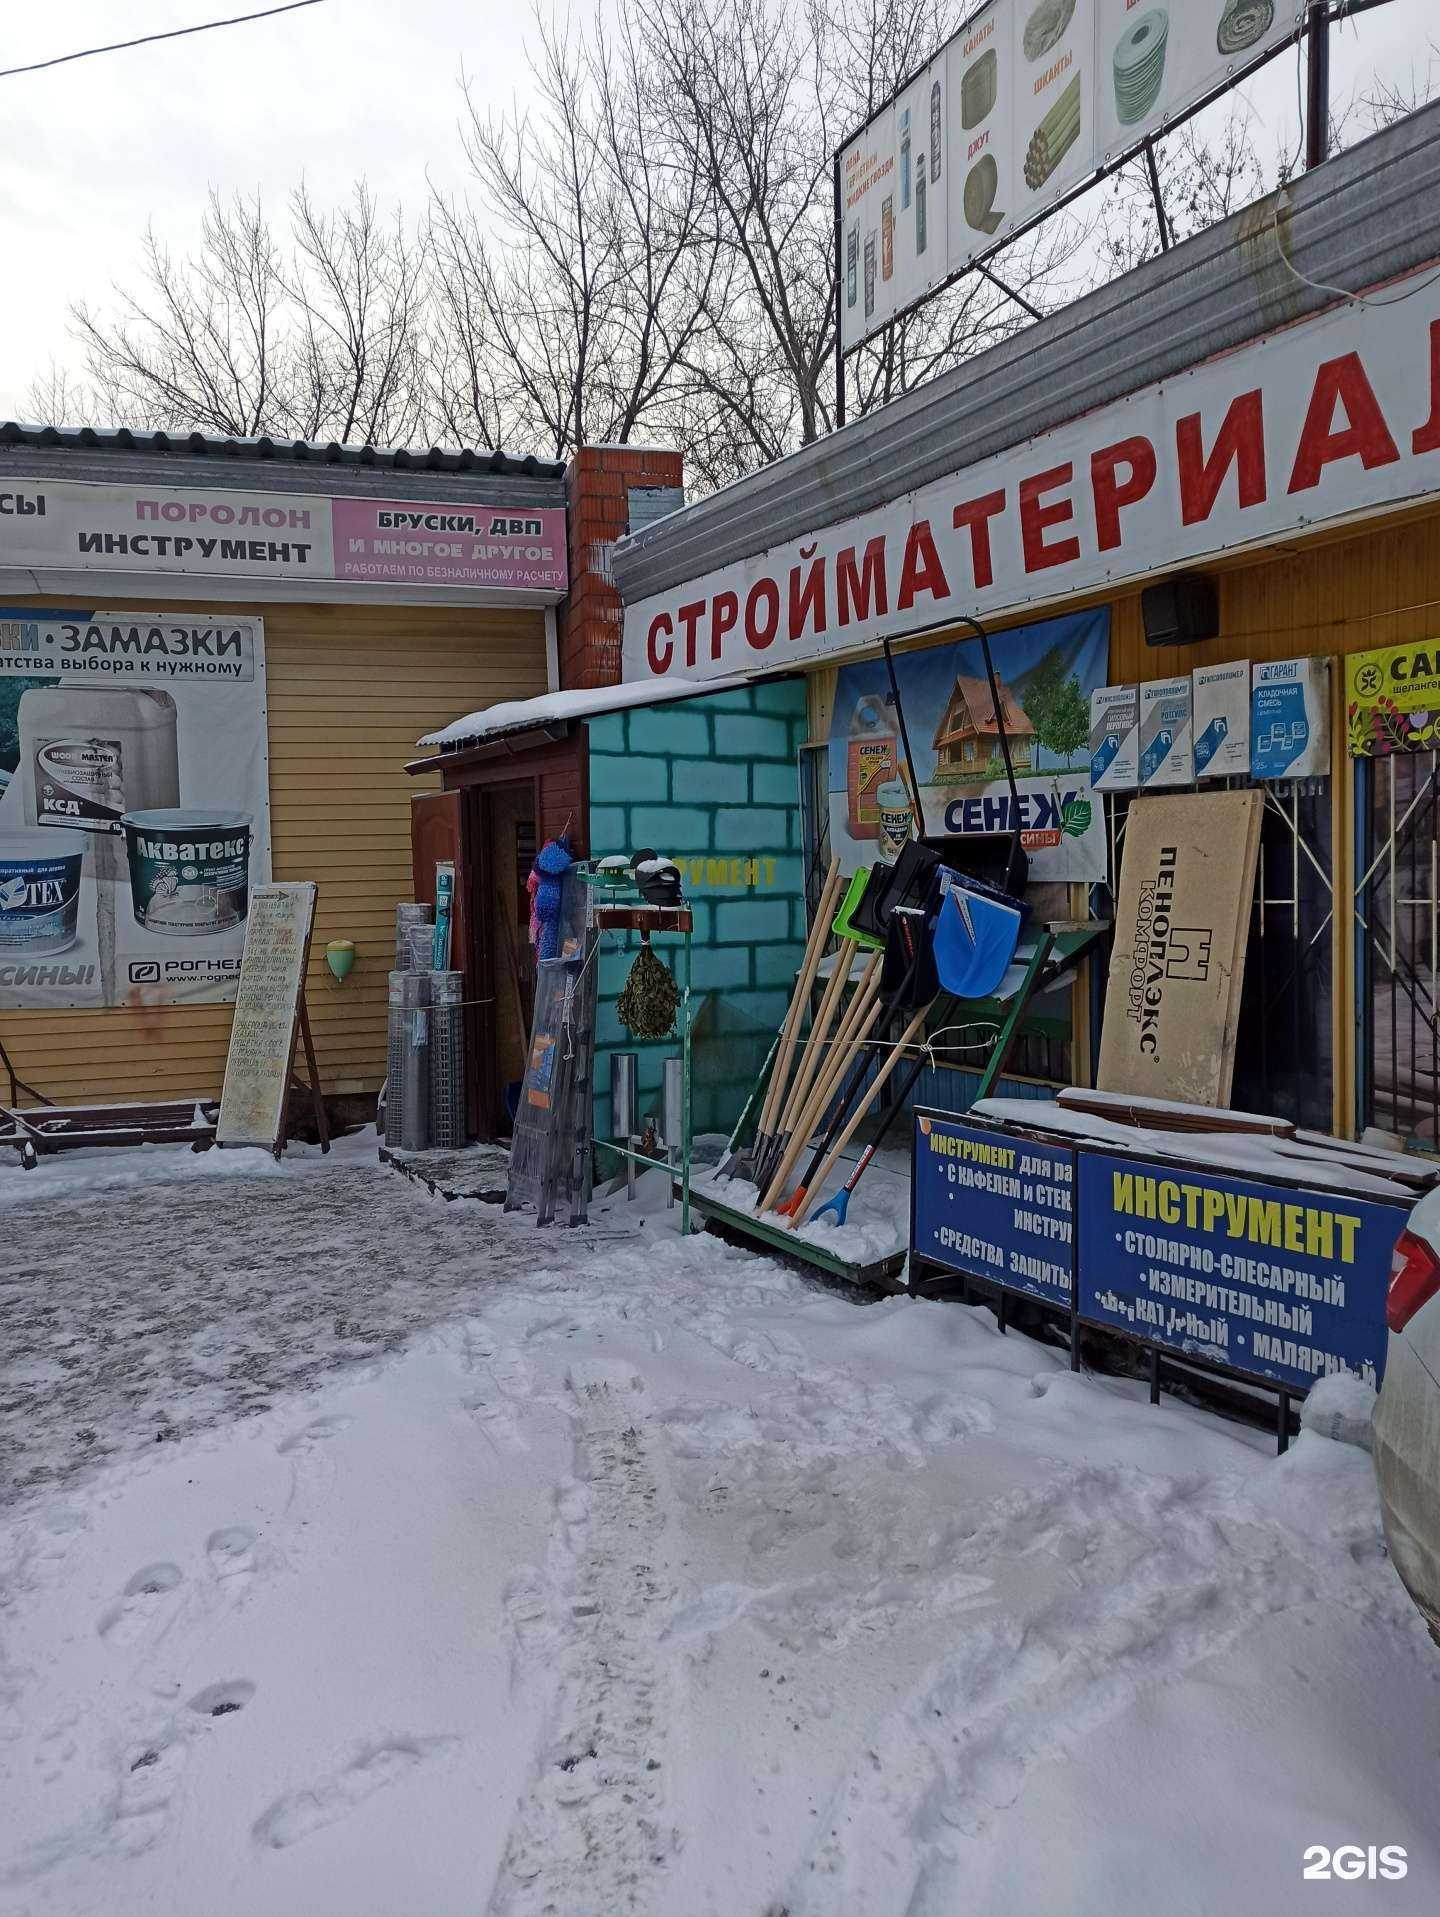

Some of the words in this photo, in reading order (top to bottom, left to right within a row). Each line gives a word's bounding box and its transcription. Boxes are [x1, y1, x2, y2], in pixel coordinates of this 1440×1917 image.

[963, 18, 995, 58] КАНАТЫ
[1033, 50, 1072, 95] ШКАНТЫ
[967, 130, 990, 161] ДЖУТ
[136, 500, 311, 529] ПОРОЛОН
[377, 511, 482, 536] БРУСКИ,
[489, 516, 543, 537] ДВП
[78, 532, 311, 563] ИНСТРУМЕНТ
[349, 538, 365, 553] И
[373, 540, 463, 558] МНОГОЕ
[471, 544, 554, 561] ДРУГОЕ
[345, 562, 406, 576] РАБОТАЕМ
[408, 565, 424, 577] ПО
[427, 566, 514, 581] БЕЗНАЛИЧНОМУ
[517, 570, 564, 582] РАСЧЕТУ
[60, 624, 242, 657] ЗАМАЗКИ
[61, 656, 135, 672] выбора
[140, 660, 151, 672] к
[156, 660, 243, 677] нужному
[1271, 663, 1298, 678] ГАРАНТ
[1390, 650, 1440, 681] СА
[1258, 687, 1298, 698] КЛАДОЧНАЯ
[944, 791, 1077, 833] СЕНЕЖ
[136, 835, 245, 861] Акватекс
[1127, 880, 1157, 1022] КОМФОРТ
[930, 1133, 1015, 1170] ИНСТРУМЕНТ
[1019, 1155, 1051, 1178] для
[947, 1163, 956, 1183] С
[958, 1165, 1021, 1199] КАФЕЛЕМ
[1113, 1171, 1361, 1264] ИНСТРУМЕНТ
[940, 1226, 1004, 1268] СРЕДСТВА
[1125, 1230, 1345, 1308] СТОЛЯРНО-СЛЕСАРНЫЙ
[1149, 1268, 1313, 1336] ИЗМЕРИТЕЛЬНЫЙ
